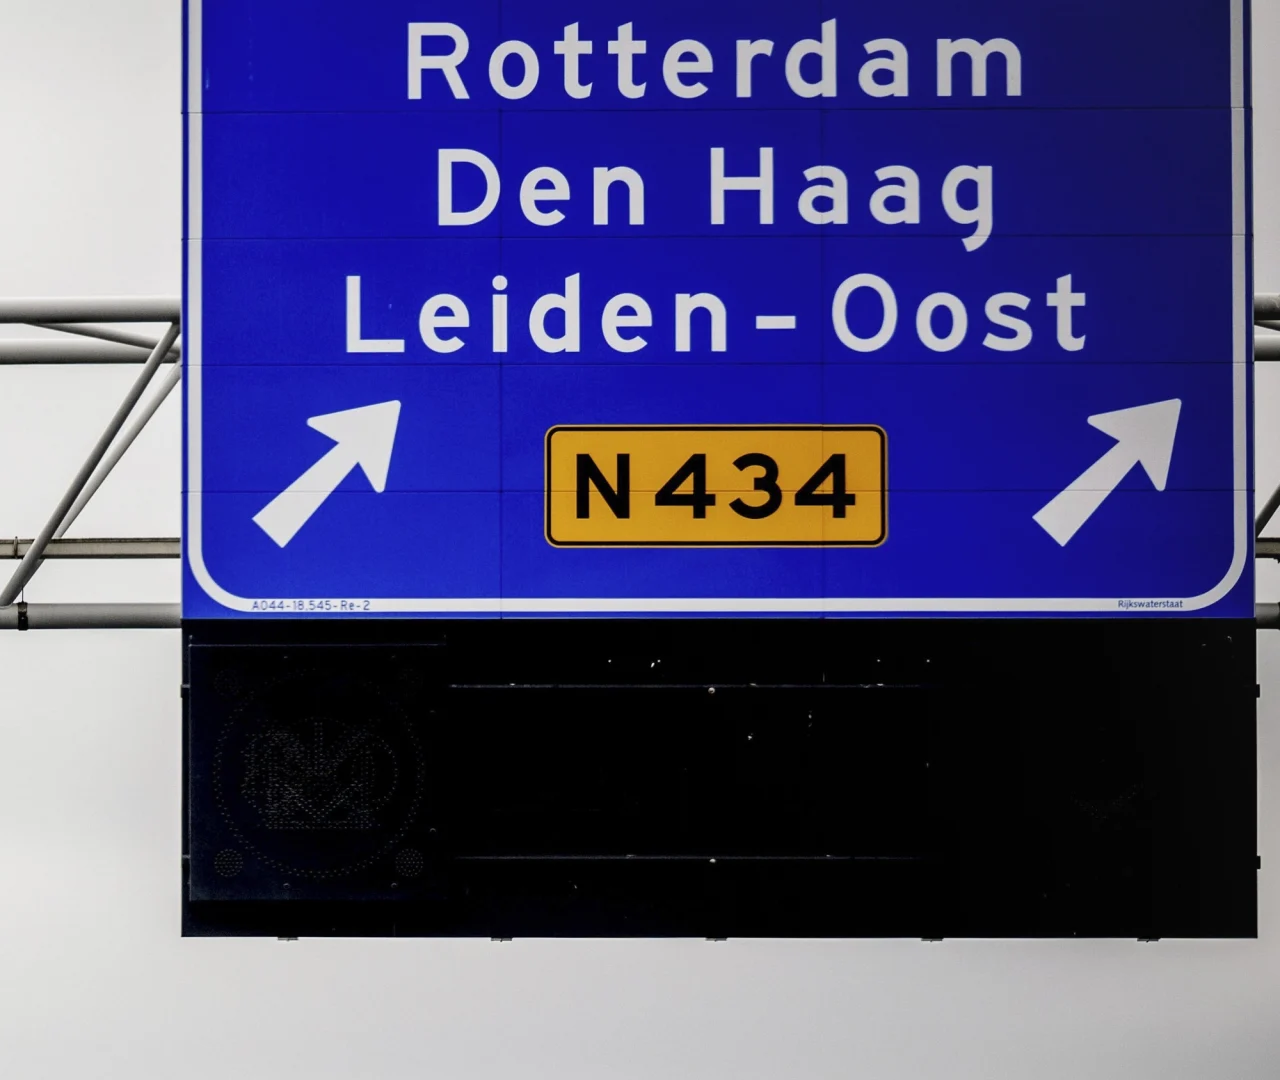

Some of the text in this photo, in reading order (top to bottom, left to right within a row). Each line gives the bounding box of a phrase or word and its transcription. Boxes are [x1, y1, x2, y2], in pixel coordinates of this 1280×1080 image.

[407, 18, 1022, 100] Rotterdam
[438, 146, 994, 252] Den Haag
[1118, 599, 1183, 610] Rijkswaterstaat
